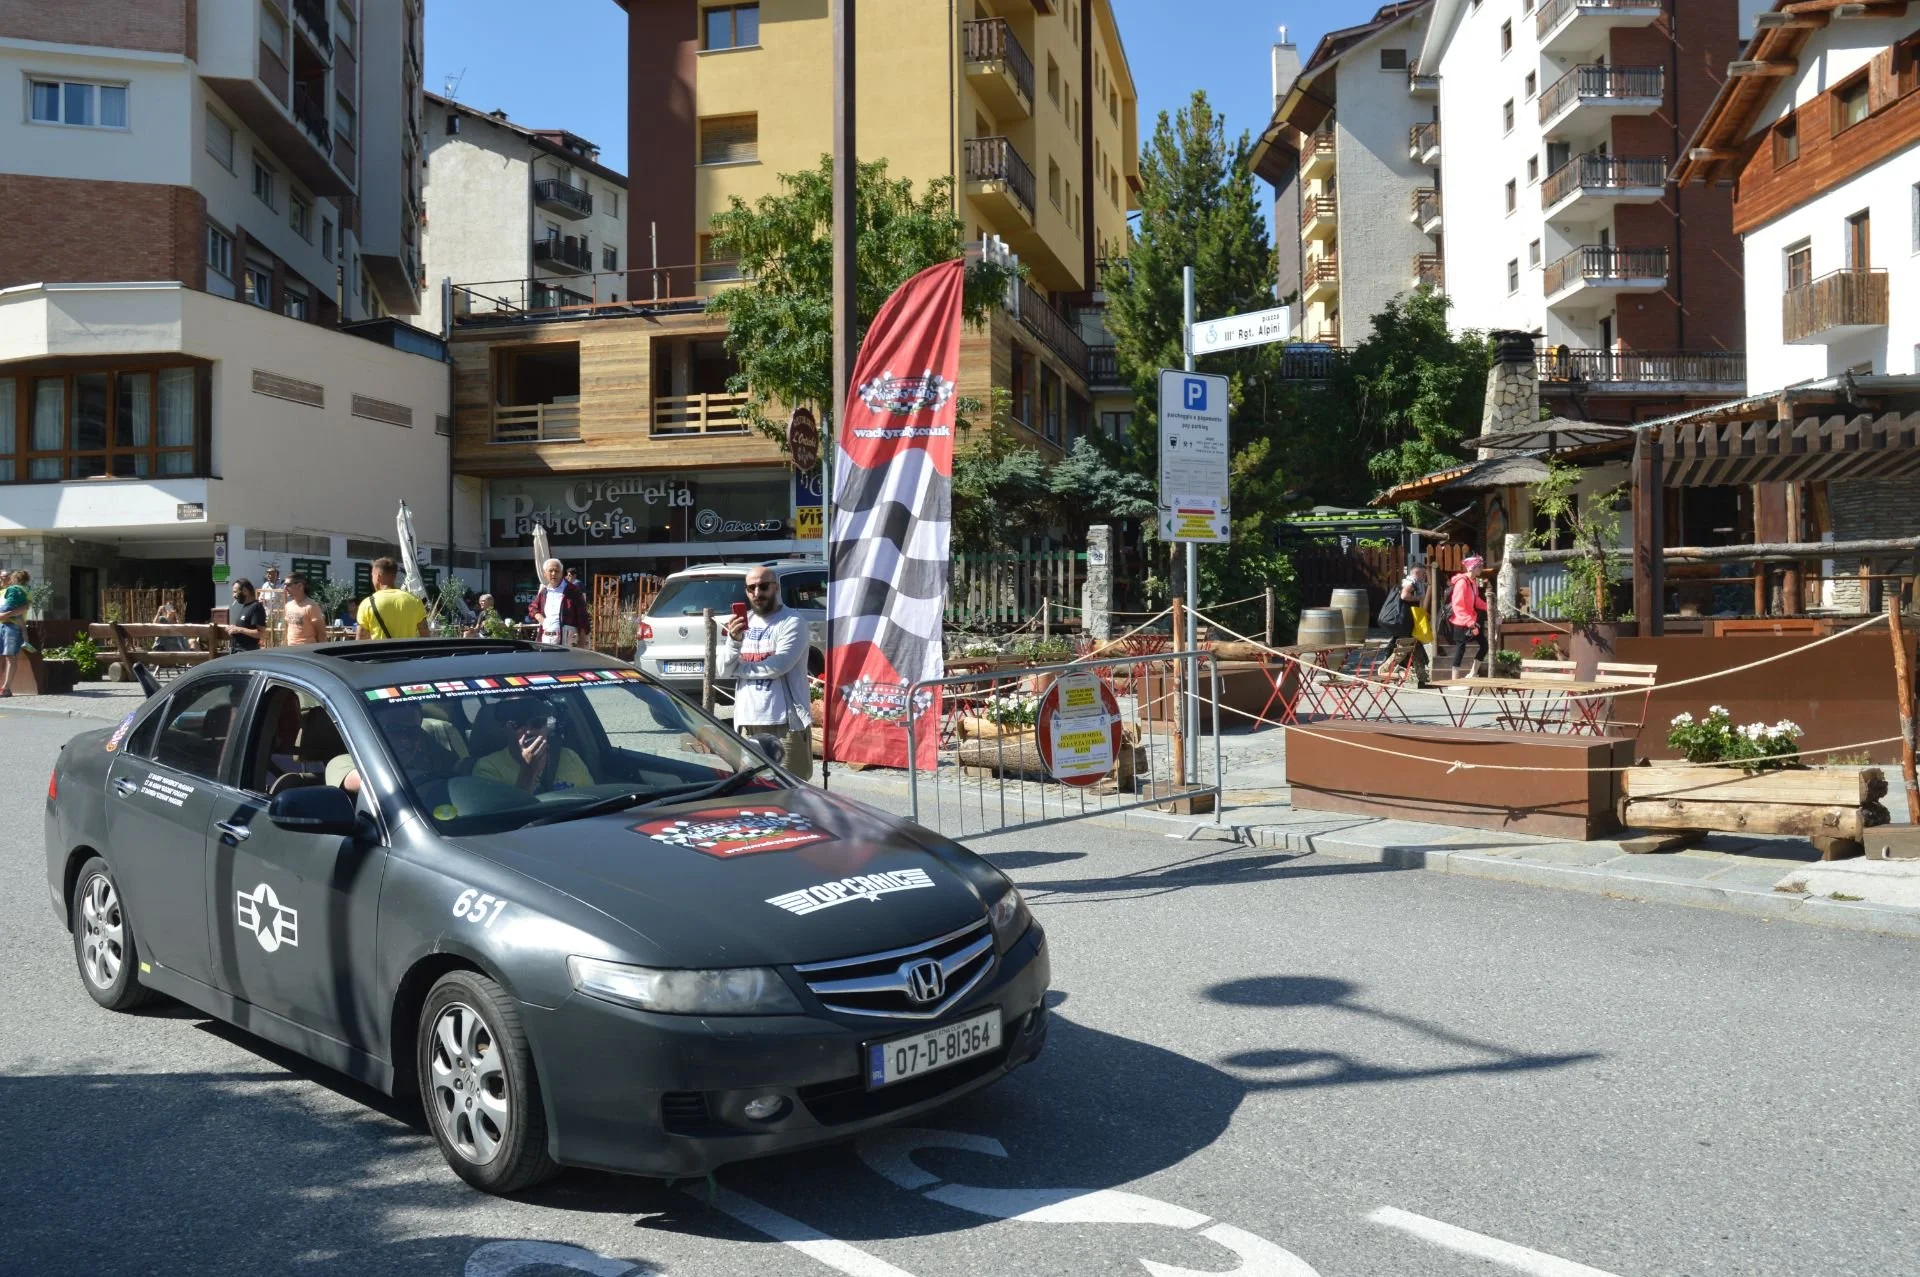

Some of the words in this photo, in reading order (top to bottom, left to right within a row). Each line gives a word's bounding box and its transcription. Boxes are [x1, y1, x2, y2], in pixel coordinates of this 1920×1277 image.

[1238, 328, 1254, 341] Rgt.
[1258, 323, 1281, 338] Alpini
[853, 425, 951, 439] wackyrally.co.uk
[565, 474, 695, 513] Cremeria
[500, 493, 637, 540] Pasticceria
[388, 693, 441, 704] #wackyrally
[453, 888, 508, 928] 651
[896, 1021, 990, 1075] 07-D-81364
